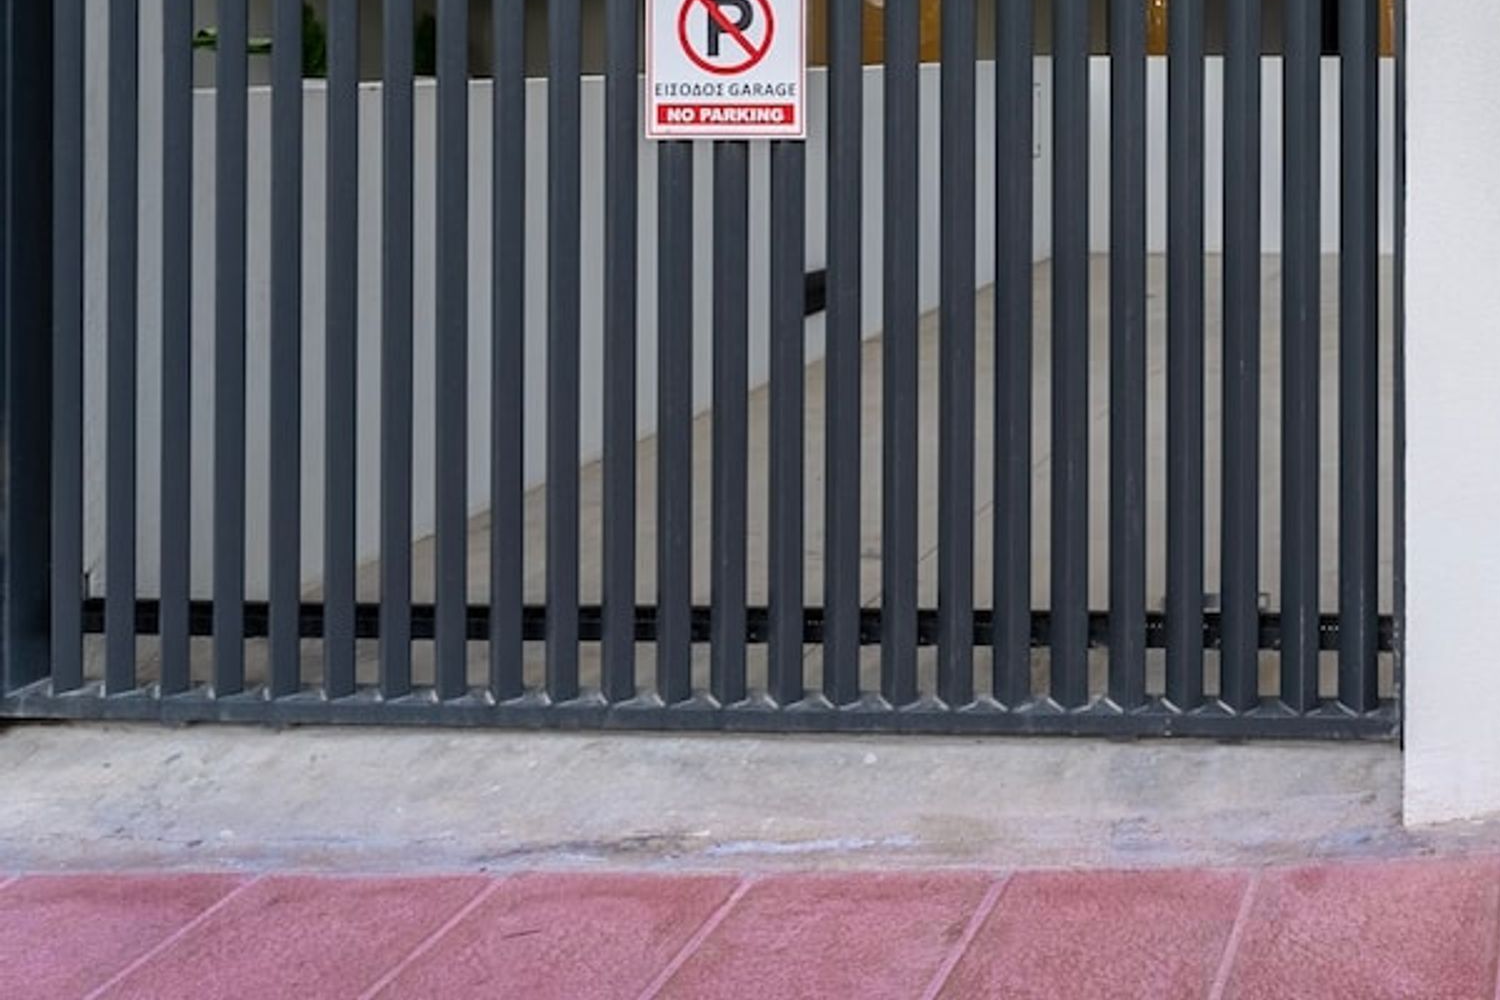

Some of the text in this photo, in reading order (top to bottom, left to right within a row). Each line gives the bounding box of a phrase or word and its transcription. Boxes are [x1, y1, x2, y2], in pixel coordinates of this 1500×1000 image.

[655, 82, 797, 97] ΕΙΣΟΔΟΣ GARAGE
[667, 108, 785, 122] NO PARKING
